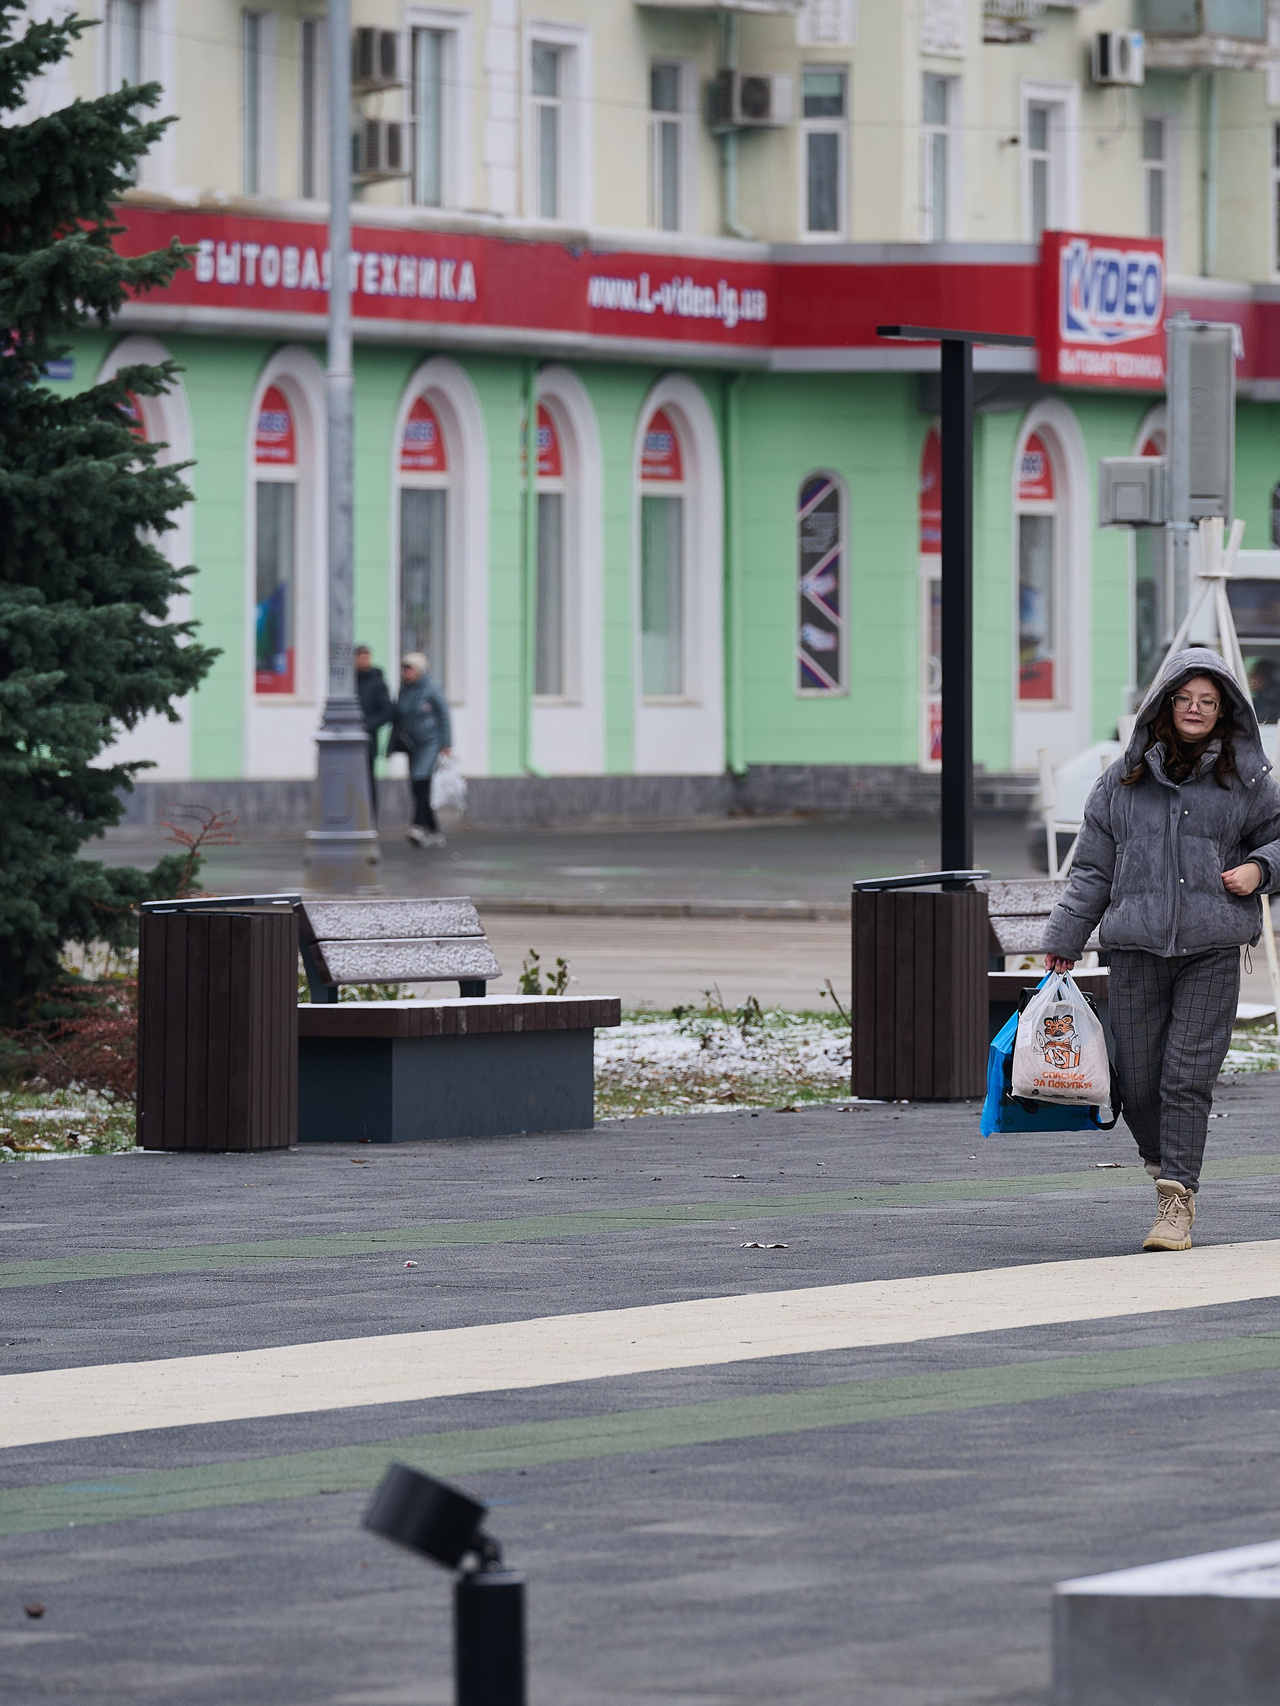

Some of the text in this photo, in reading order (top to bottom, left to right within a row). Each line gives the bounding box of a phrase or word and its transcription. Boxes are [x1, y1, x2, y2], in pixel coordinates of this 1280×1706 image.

[349, 251, 477, 302] ТЕХНИКА
[1042, 1071, 1085, 1080] СПАСИБО
[1033, 1078, 1046, 1087] ЗА
